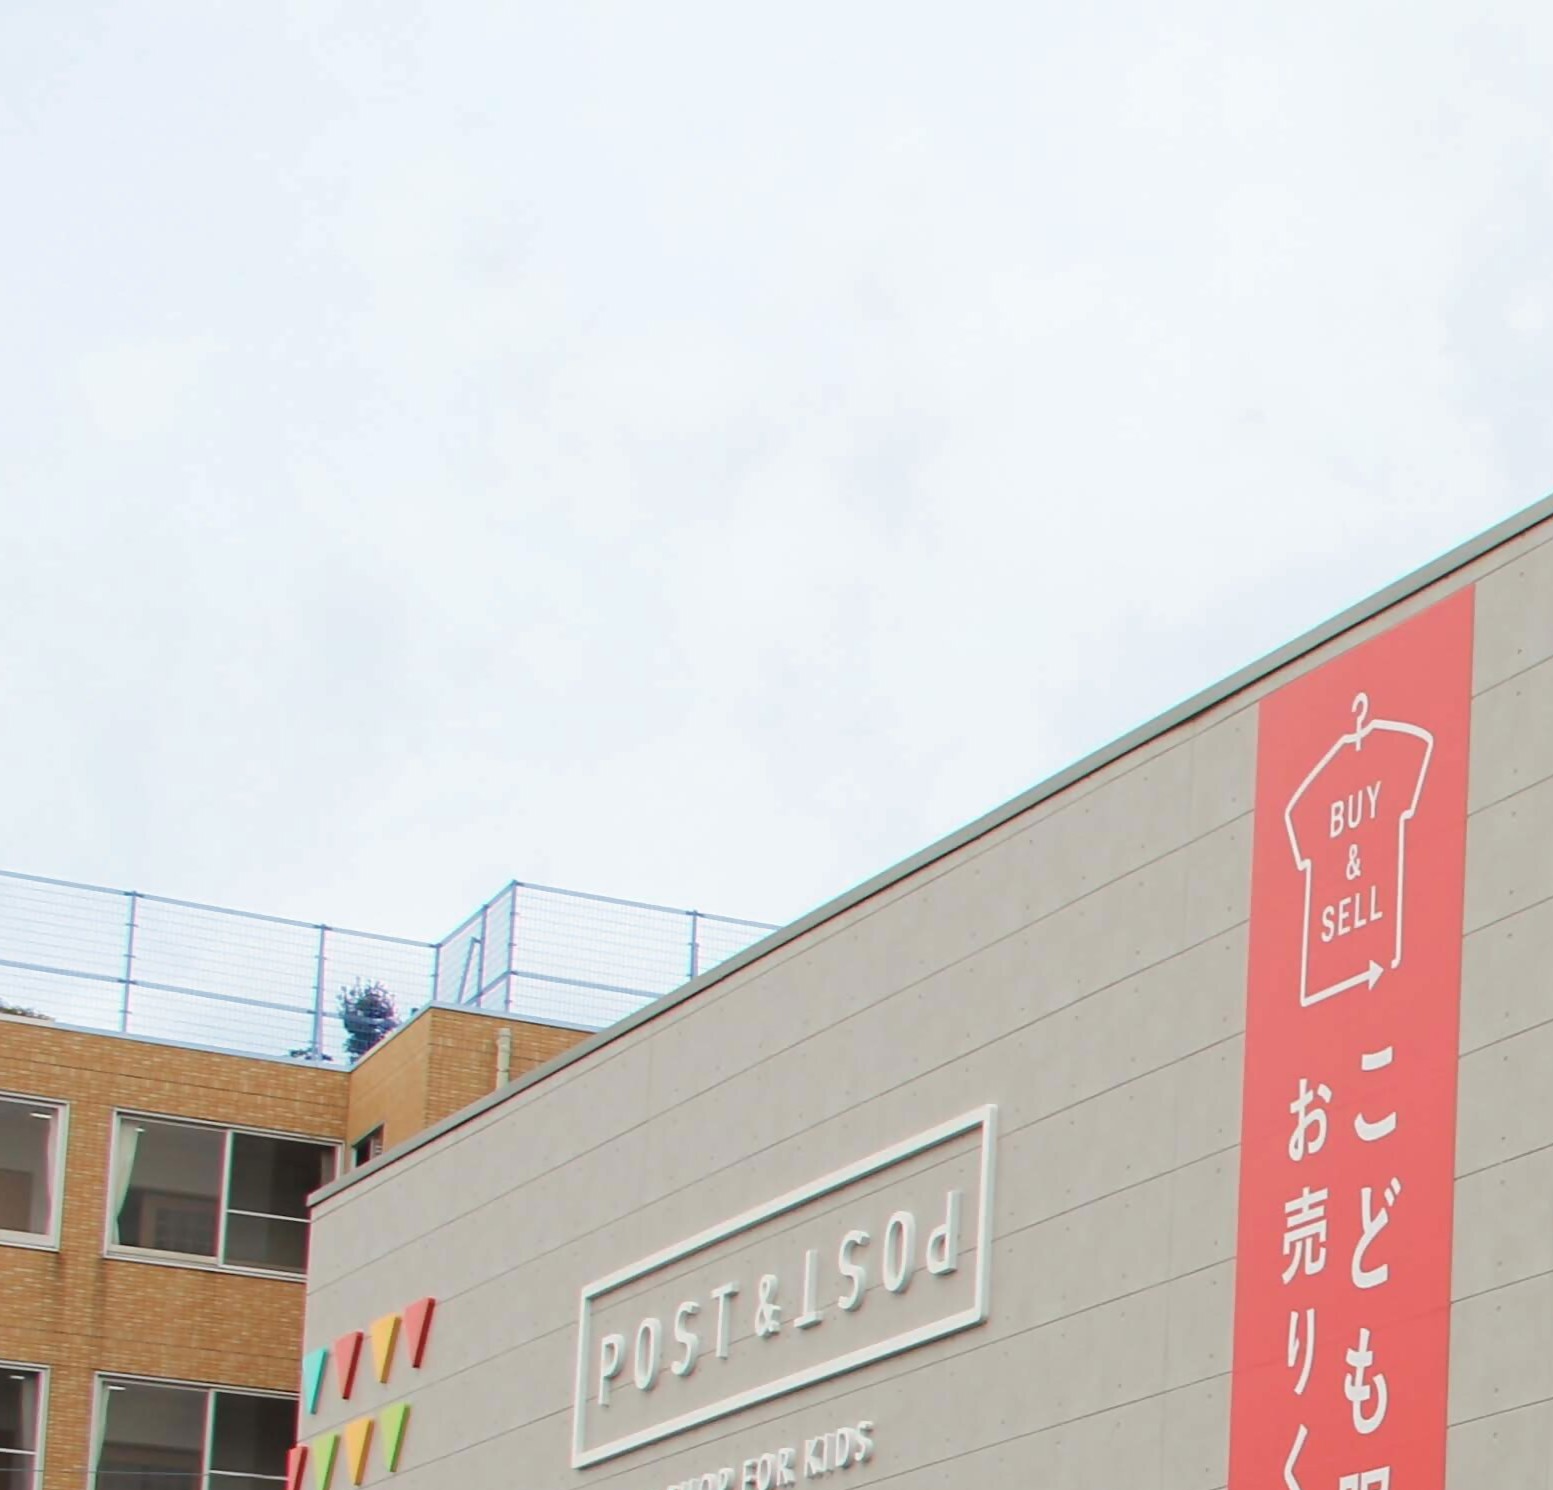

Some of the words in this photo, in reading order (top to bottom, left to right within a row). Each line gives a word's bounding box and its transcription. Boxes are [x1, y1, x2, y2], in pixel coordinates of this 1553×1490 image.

[1328, 781, 1381, 839] BUY
[1344, 844, 1362, 880] &
[1320, 886, 1383, 943] SELL
[598, 1281, 739, 1407] POST
[804, 1420, 875, 1479] KIDS
